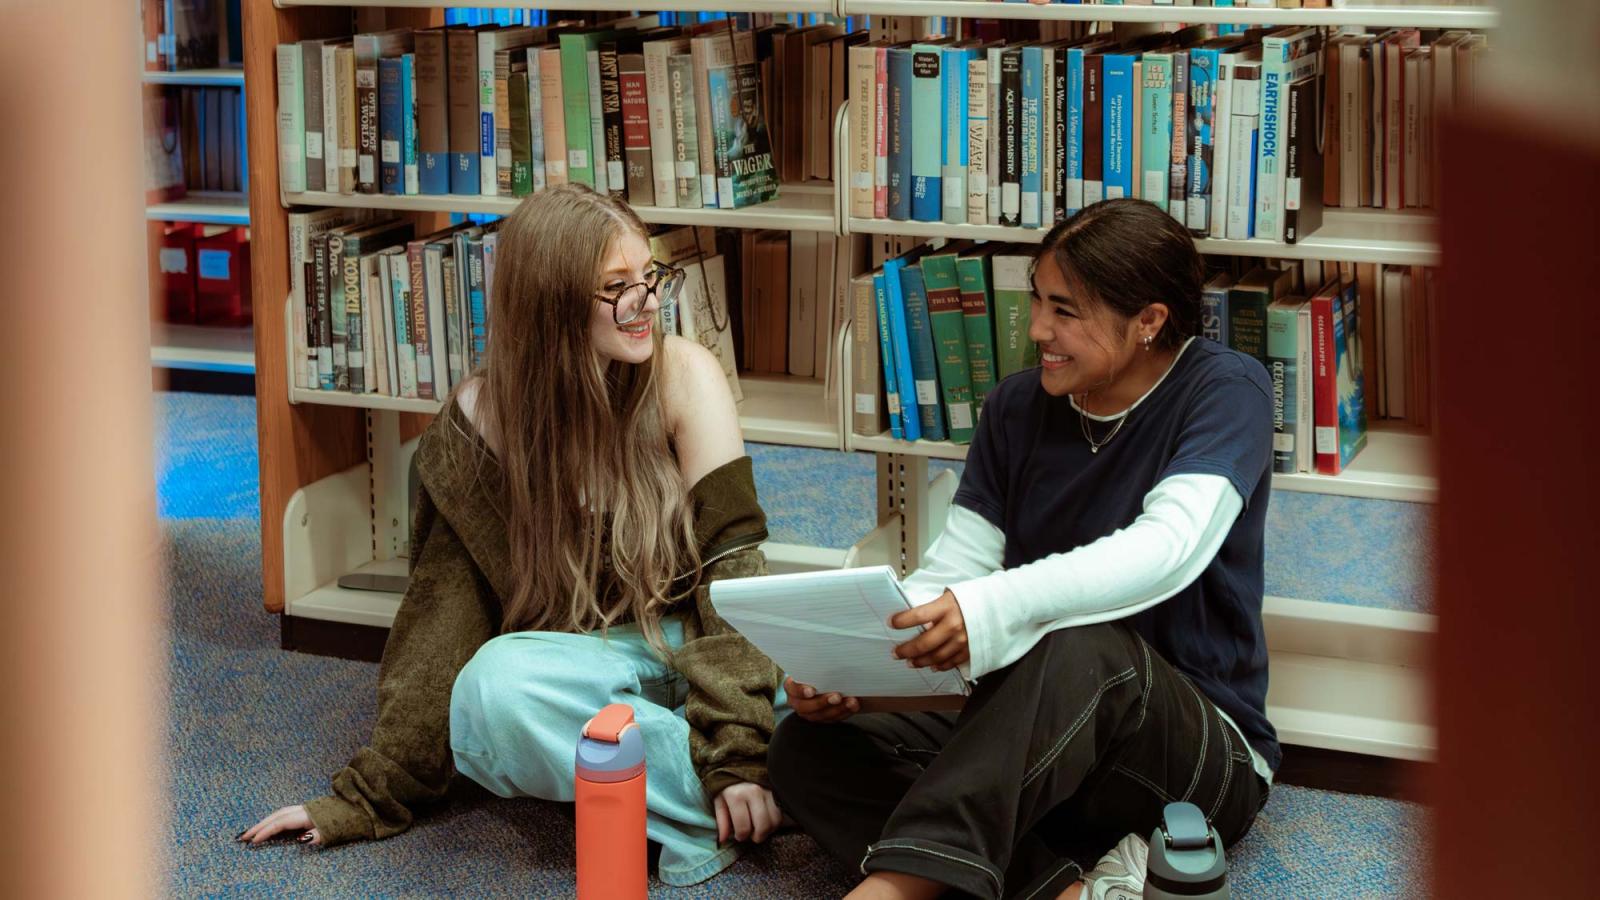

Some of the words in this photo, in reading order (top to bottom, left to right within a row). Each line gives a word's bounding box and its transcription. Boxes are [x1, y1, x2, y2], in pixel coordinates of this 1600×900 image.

[601, 51, 617, 78] LOST
[602, 79, 619, 94] AT
[1056, 76, 1064, 88] Soil
[369, 92, 377, 117] OVER
[604, 95, 620, 114] SEA
[672, 71, 685, 139] COLLISION
[1006, 89, 1015, 125] AQUATIC
[1029, 98, 1038, 114] THE
[1056, 90, 1065, 109] Water
[361, 104, 370, 148] WORLD
[1056, 110, 1064, 122] and
[1070, 115, 1078, 135] View
[1173, 92, 1185, 164] MEGADISASTERS
[1263, 72, 1279, 158] EARTHSHOCK
[368, 125, 377, 152] EDGE
[1029, 115, 1038, 174] GEOCHEMISTRY
[1056, 123, 1065, 148] Ground
[1006, 125, 1015, 176] CHEMISTRY
[1056, 148, 1065, 168] Water
[1070, 144, 1078, 158] the
[1114, 142, 1122, 173] Chemistry
[677, 141, 689, 197] COSE
[732, 153, 774, 177] WAGER
[1070, 159, 1078, 179] Rive
[1192, 136, 1203, 193] ENVIRONMENTAL
[1055, 168, 1065, 196] Sampling
[316, 249, 324, 283] HEART
[343, 257, 360, 313] KODOKU
[317, 293, 325, 312] SEA
[877, 288, 888, 342] OCEANOGRAPHY
[1008, 304, 1019, 327] The
[1009, 330, 1020, 349] Sea
[1202, 314, 1220, 342] SE
[1272, 361, 1285, 432] OCEANOGRAPHY
